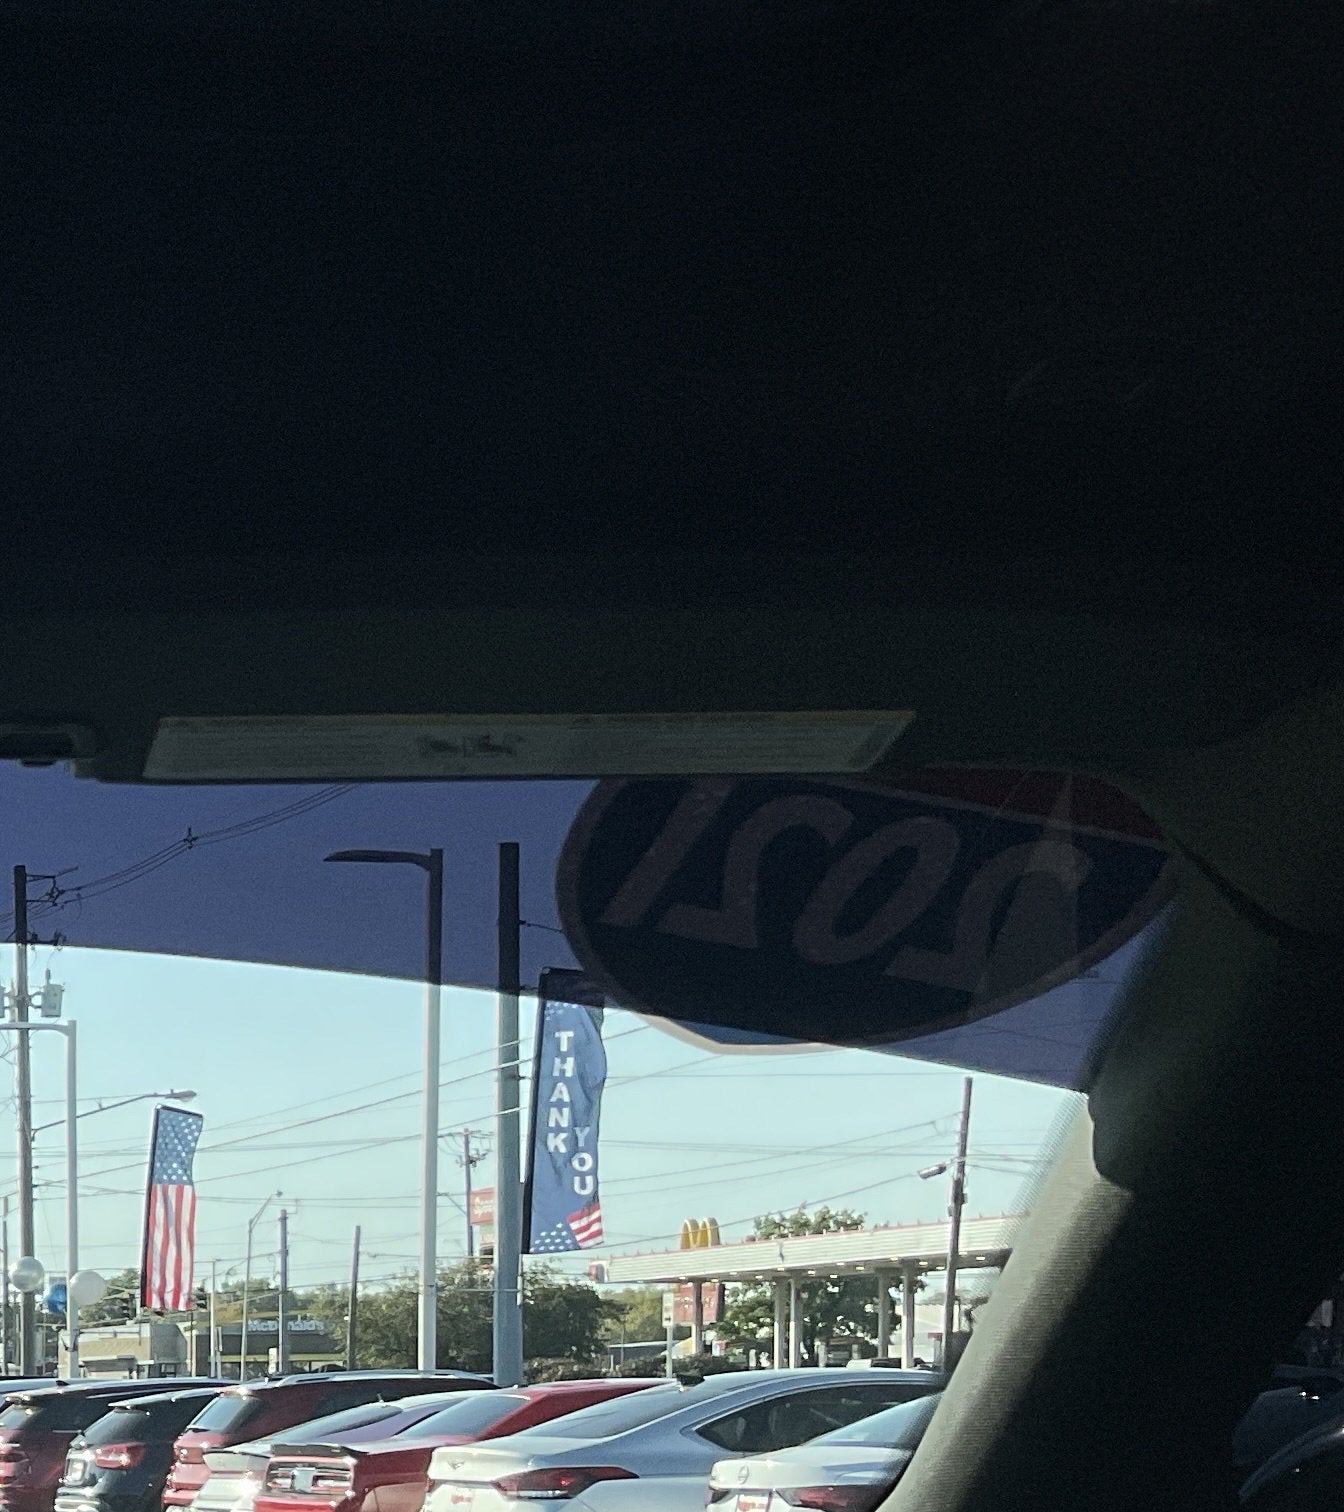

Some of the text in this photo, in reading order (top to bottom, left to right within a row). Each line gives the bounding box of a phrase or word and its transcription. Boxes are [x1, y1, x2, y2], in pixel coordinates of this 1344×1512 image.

[546, 1031, 575, 1154] THANK
[572, 1127, 594, 1195] YOU
[247, 1314, 324, 1331] McDnald's
